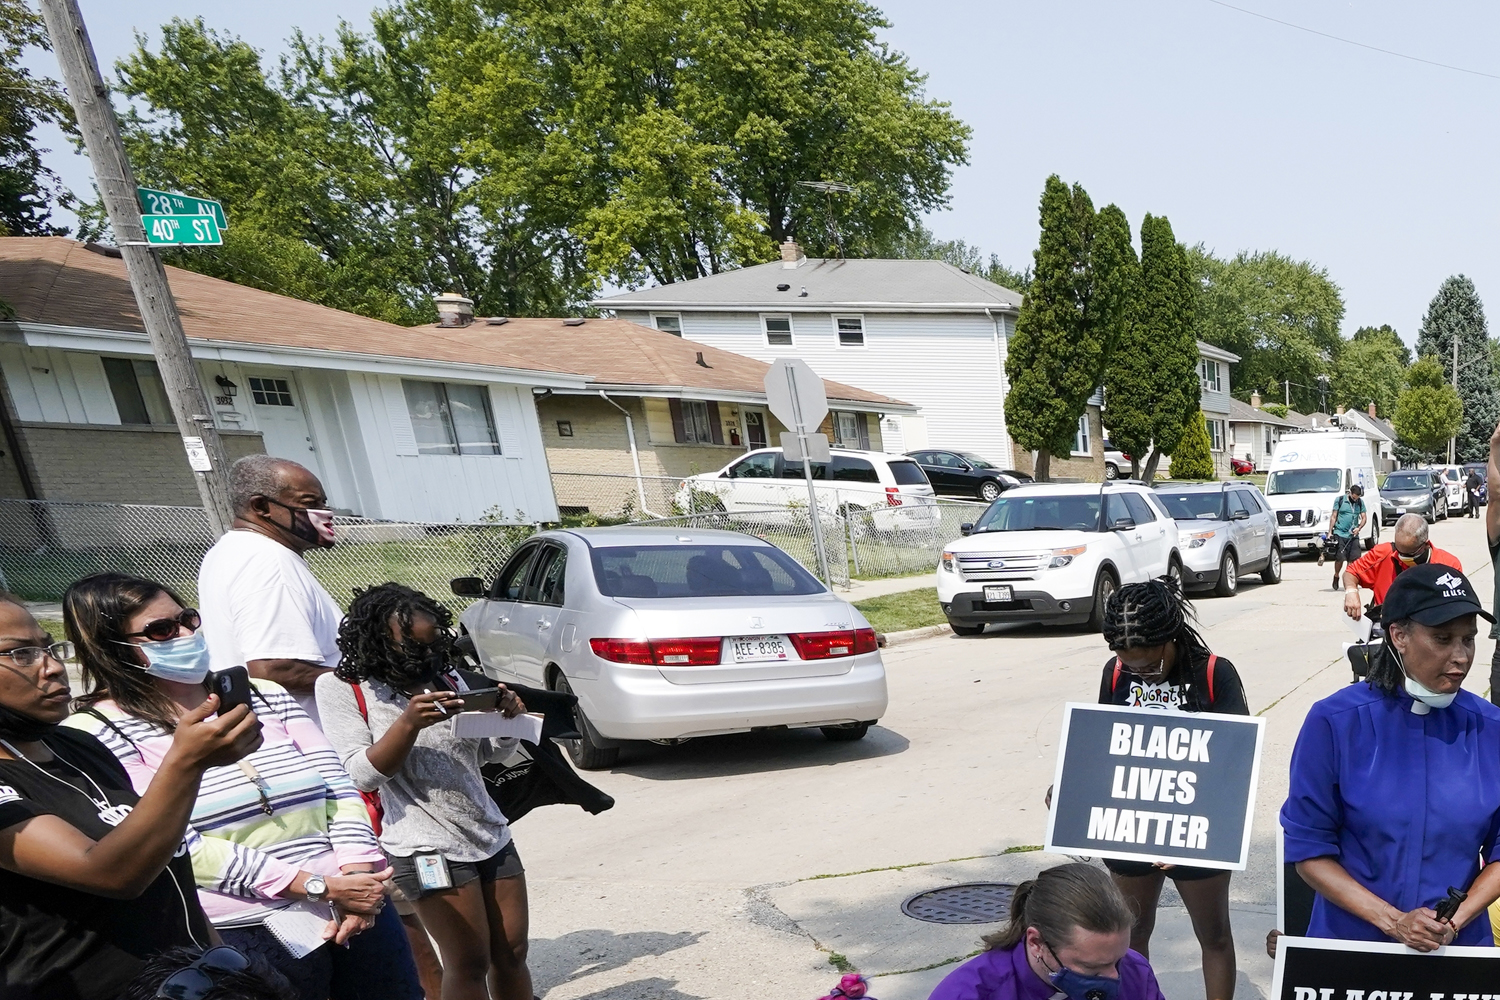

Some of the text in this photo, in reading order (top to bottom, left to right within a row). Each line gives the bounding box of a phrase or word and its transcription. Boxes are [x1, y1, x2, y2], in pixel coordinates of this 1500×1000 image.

[152, 218, 213, 241] 40TH ST
[1300, 453, 1337, 462] NEWS
[735, 641, 785, 656] AEE-8385
[1109, 722, 1213, 763] BLACK
[1111, 765, 1197, 805] LIVES
[1087, 806, 1210, 850] MATTER
